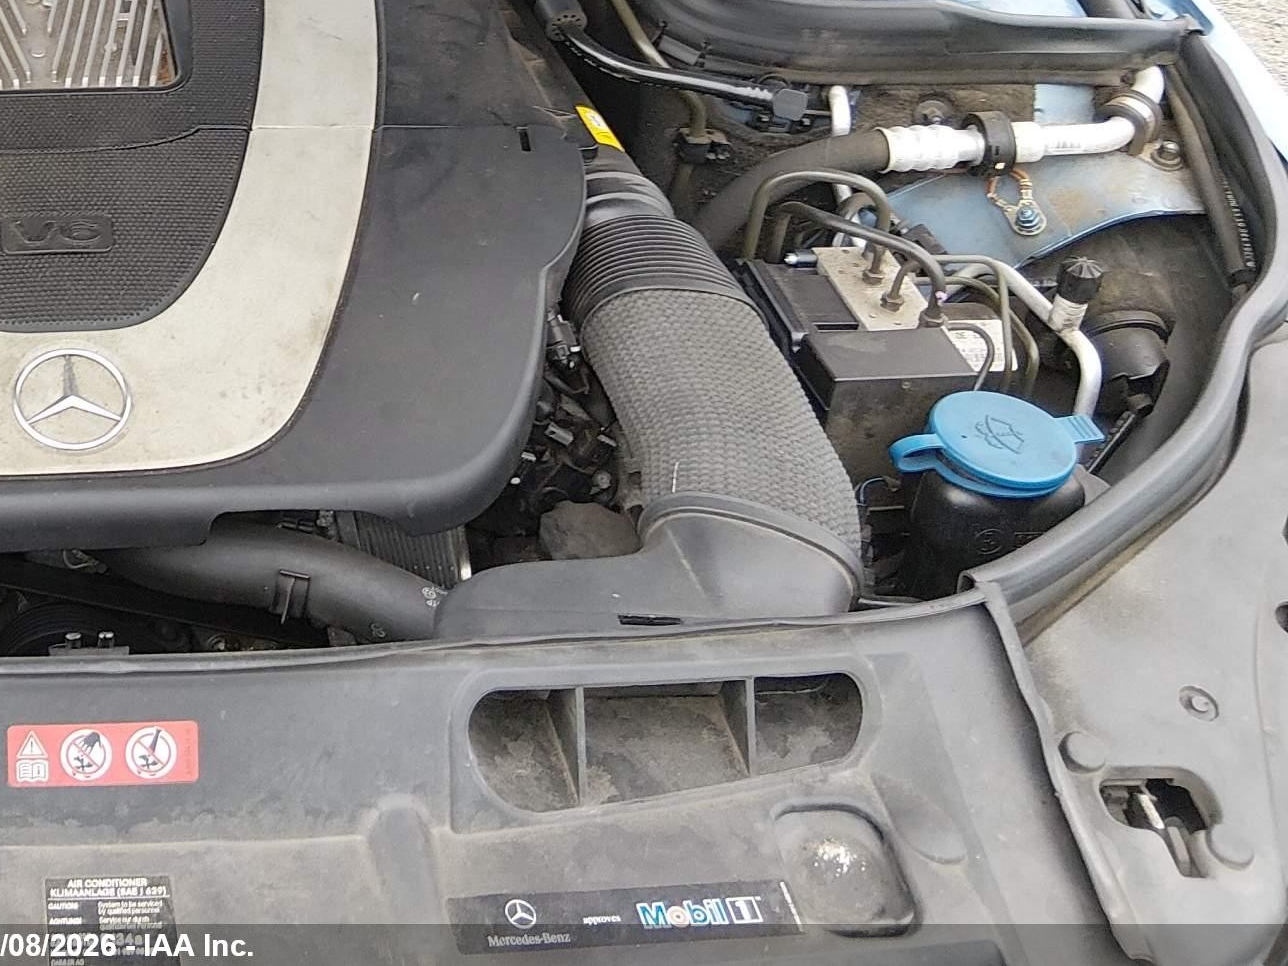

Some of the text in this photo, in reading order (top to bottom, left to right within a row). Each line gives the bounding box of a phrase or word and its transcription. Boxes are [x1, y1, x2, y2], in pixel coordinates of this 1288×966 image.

[67, 877, 148, 888] AIR CONDITIONER
[636, 898, 729, 929] Mobil
[487, 932, 571, 947] Mercedes-Benz
